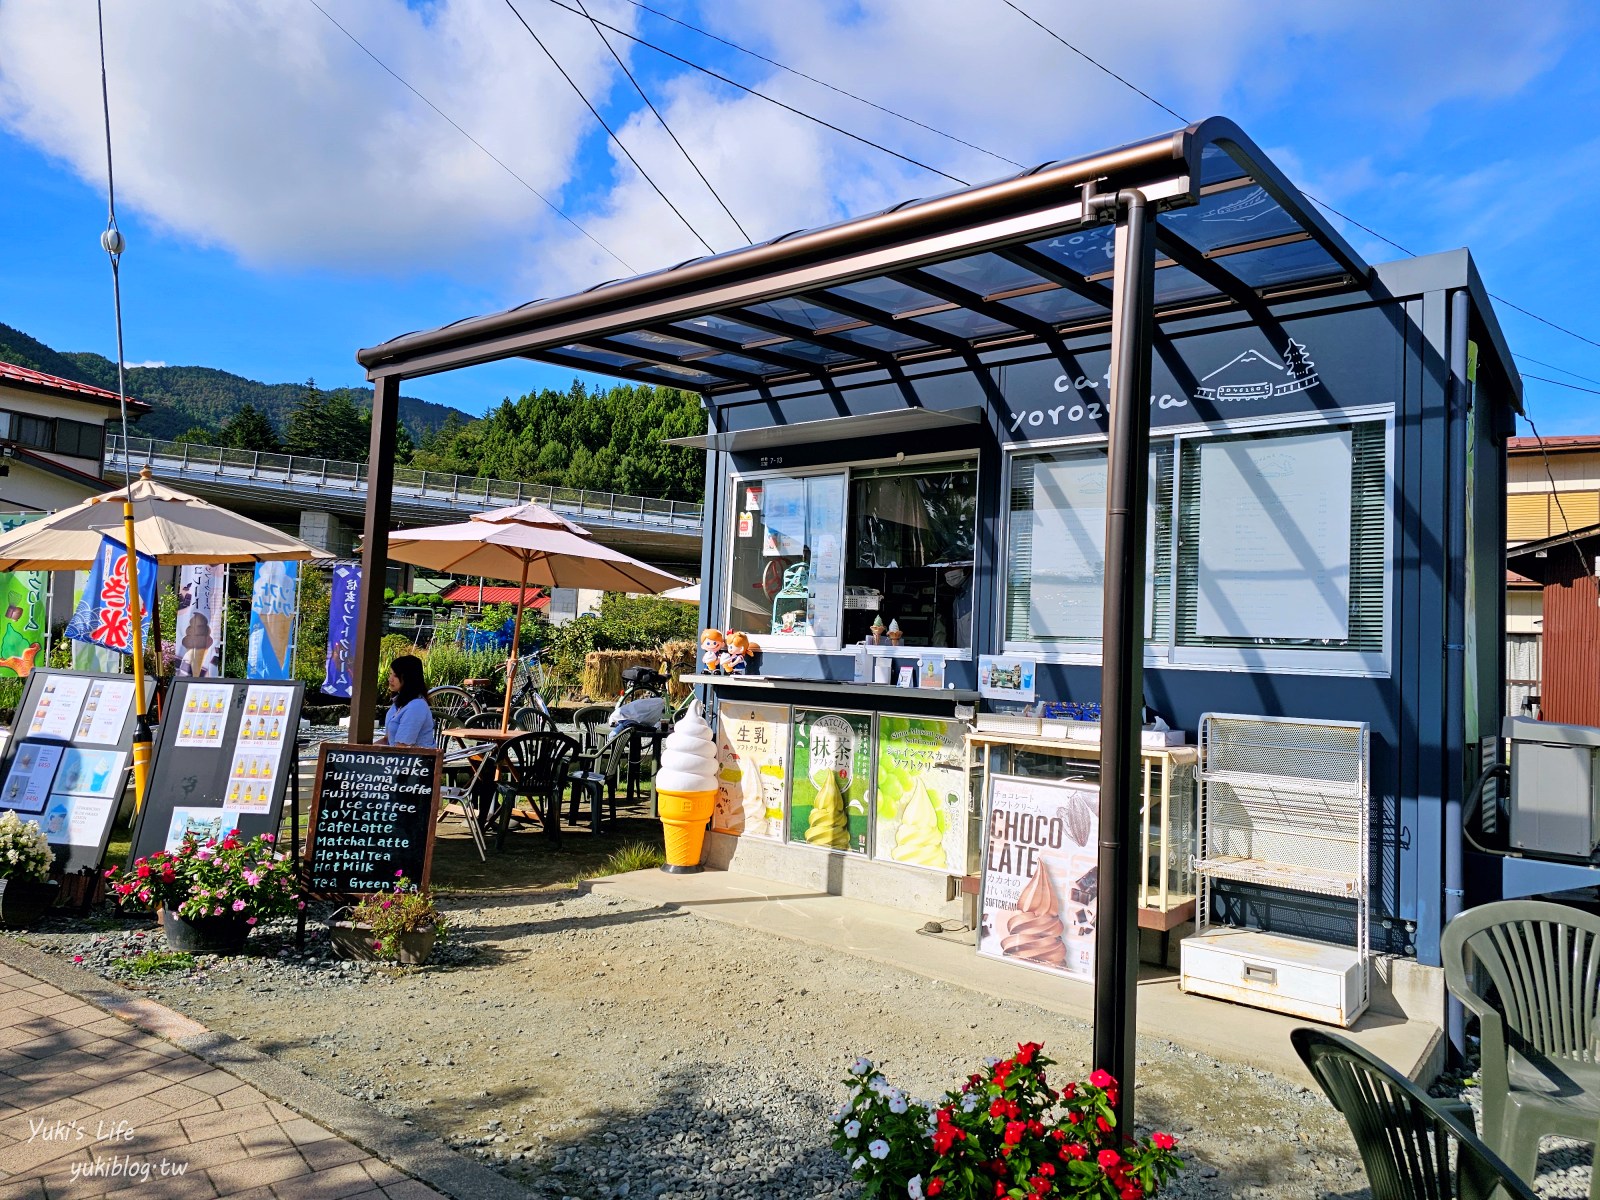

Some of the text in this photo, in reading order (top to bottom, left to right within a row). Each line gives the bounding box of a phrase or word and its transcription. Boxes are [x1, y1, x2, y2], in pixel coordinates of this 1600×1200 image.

[1010, 394, 1188, 432] yoroza
[816, 718, 848, 733] MATCHA
[737, 725, 768, 744] 生乳
[811, 736, 852, 761] 抹茶
[325, 771, 393, 784] Fujiyama
[340, 781, 398, 792] Blended
[322, 789, 390, 800] Fujiyama
[340, 800, 417, 813] Ice coffee
[991, 809, 1063, 849] CHOCO
[315, 850, 391, 861] Herbal Tea
[988, 841, 1039, 878] LATE
[314, 861, 374, 872] Hot Milk
[312, 878, 337, 888] Tea
[349, 877, 390, 889] Green
[987, 874, 1021, 887] カカオの
